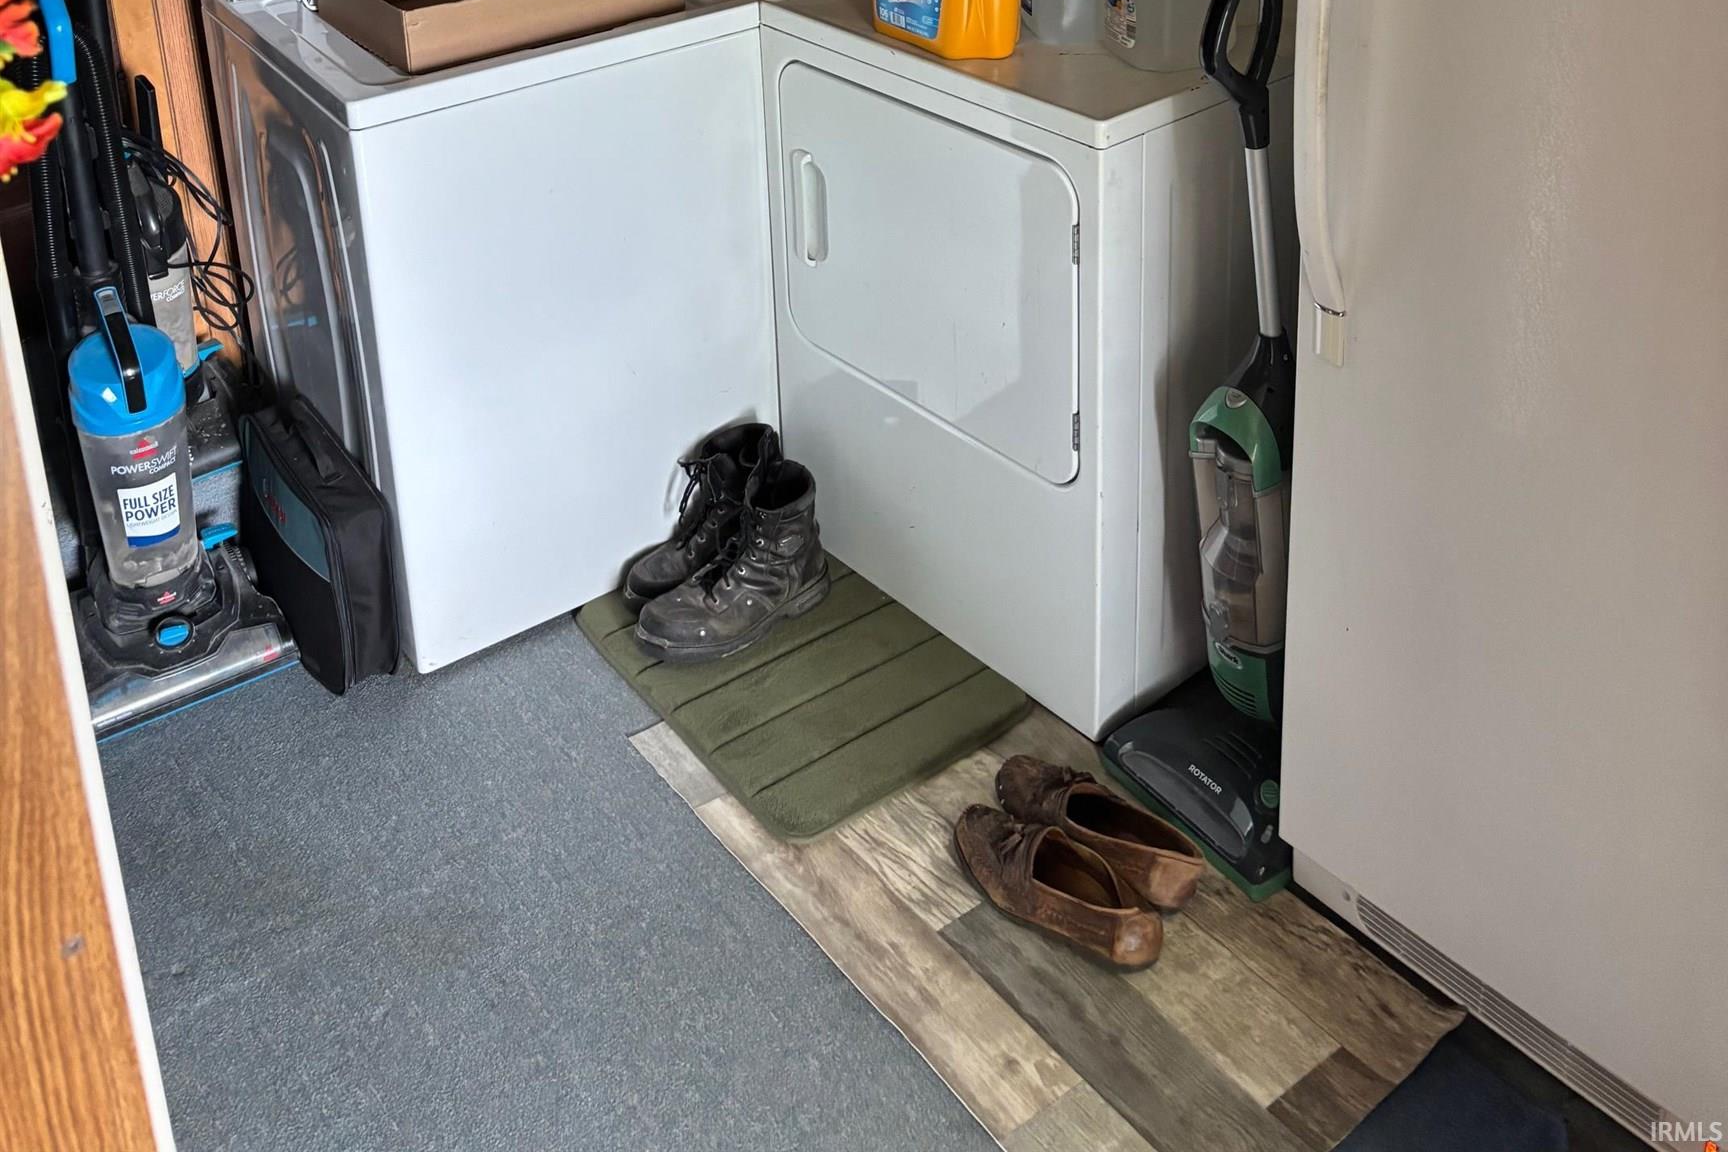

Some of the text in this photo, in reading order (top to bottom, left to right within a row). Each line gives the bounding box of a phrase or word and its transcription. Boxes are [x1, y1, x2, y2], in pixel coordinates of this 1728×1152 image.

[111, 444, 177, 475] POWERSWIFT
[148, 456, 176, 475] COMPACT
[122, 484, 174, 510] FULL SIZE
[125, 497, 176, 522] POWER
[1188, 764, 1223, 795] ROTATOR
